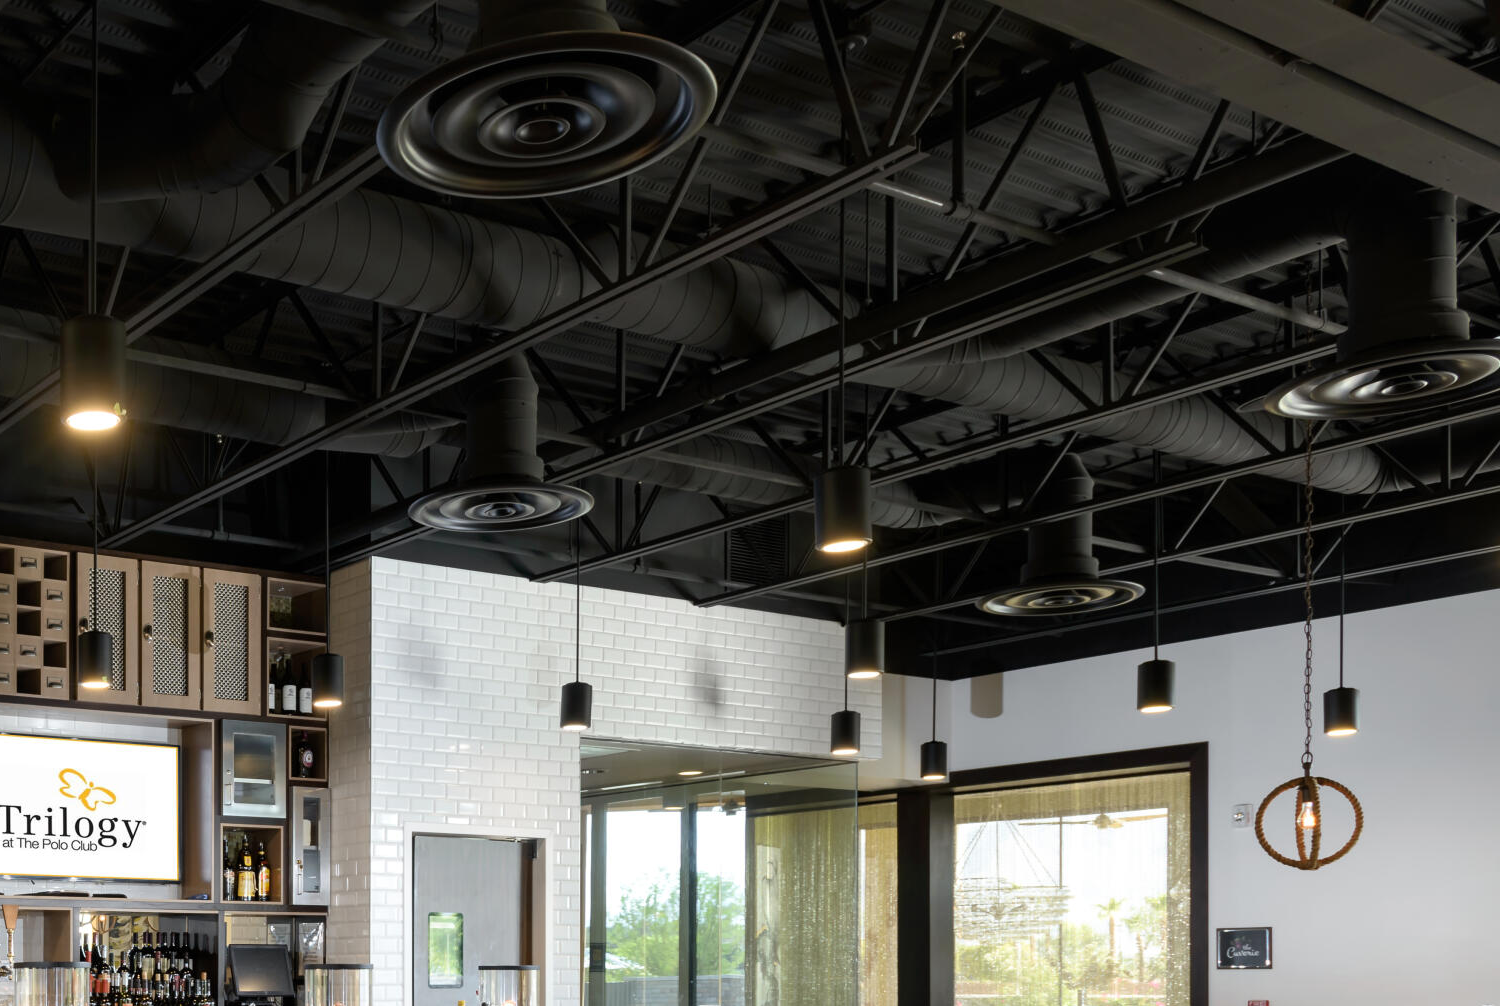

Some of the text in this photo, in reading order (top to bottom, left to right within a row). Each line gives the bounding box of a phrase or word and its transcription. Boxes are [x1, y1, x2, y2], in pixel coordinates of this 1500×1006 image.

[2, 837, 98, 852] at The Polo Club
